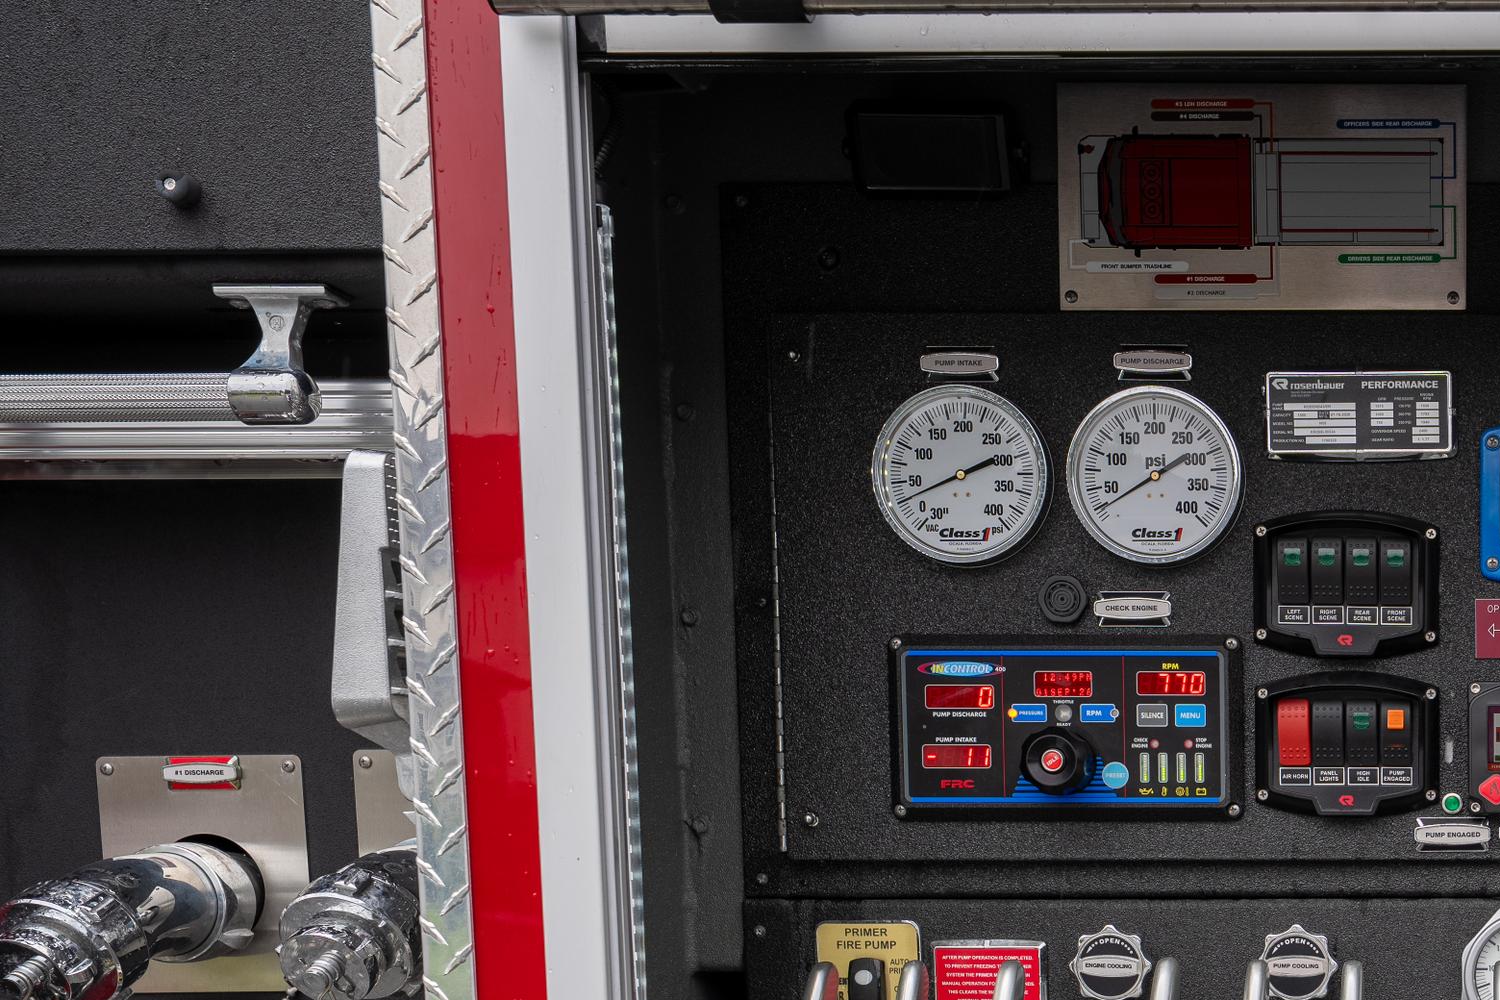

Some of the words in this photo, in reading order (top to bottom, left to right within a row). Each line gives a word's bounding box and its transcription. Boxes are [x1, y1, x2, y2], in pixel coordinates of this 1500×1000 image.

[1290, 380, 1344, 390] rosenbauer
[1361, 381, 1438, 389] PERFORMANCE
[954, 420, 973, 433] 200
[928, 428, 947, 441] 150
[982, 432, 1001, 445] 250
[914, 448, 932, 460] 100
[993, 454, 1013, 466] 300
[1145, 454, 1166, 469] psi
[908, 475, 922, 487] 50
[994, 480, 1014, 492] 350
[919, 500, 926, 512] 0
[984, 504, 1003, 516] 400
[1176, 501, 1198, 514] 400
[925, 524, 939, 533] VAC
[939, 527, 991, 541] Class1
[991, 525, 1003, 535] psi
[1132, 527, 1183, 541] Class1
[931, 663, 992, 674] INCONTROL
[1158, 673, 1205, 693] 770
[979, 687, 992, 707] 0
[1046, 755, 1059, 766] IDLE
[941, 779, 975, 789] FRC
[845, 928, 887, 936] PRIMER
[837, 941, 861, 949] FIRE
[865, 941, 896, 949] PUMP
